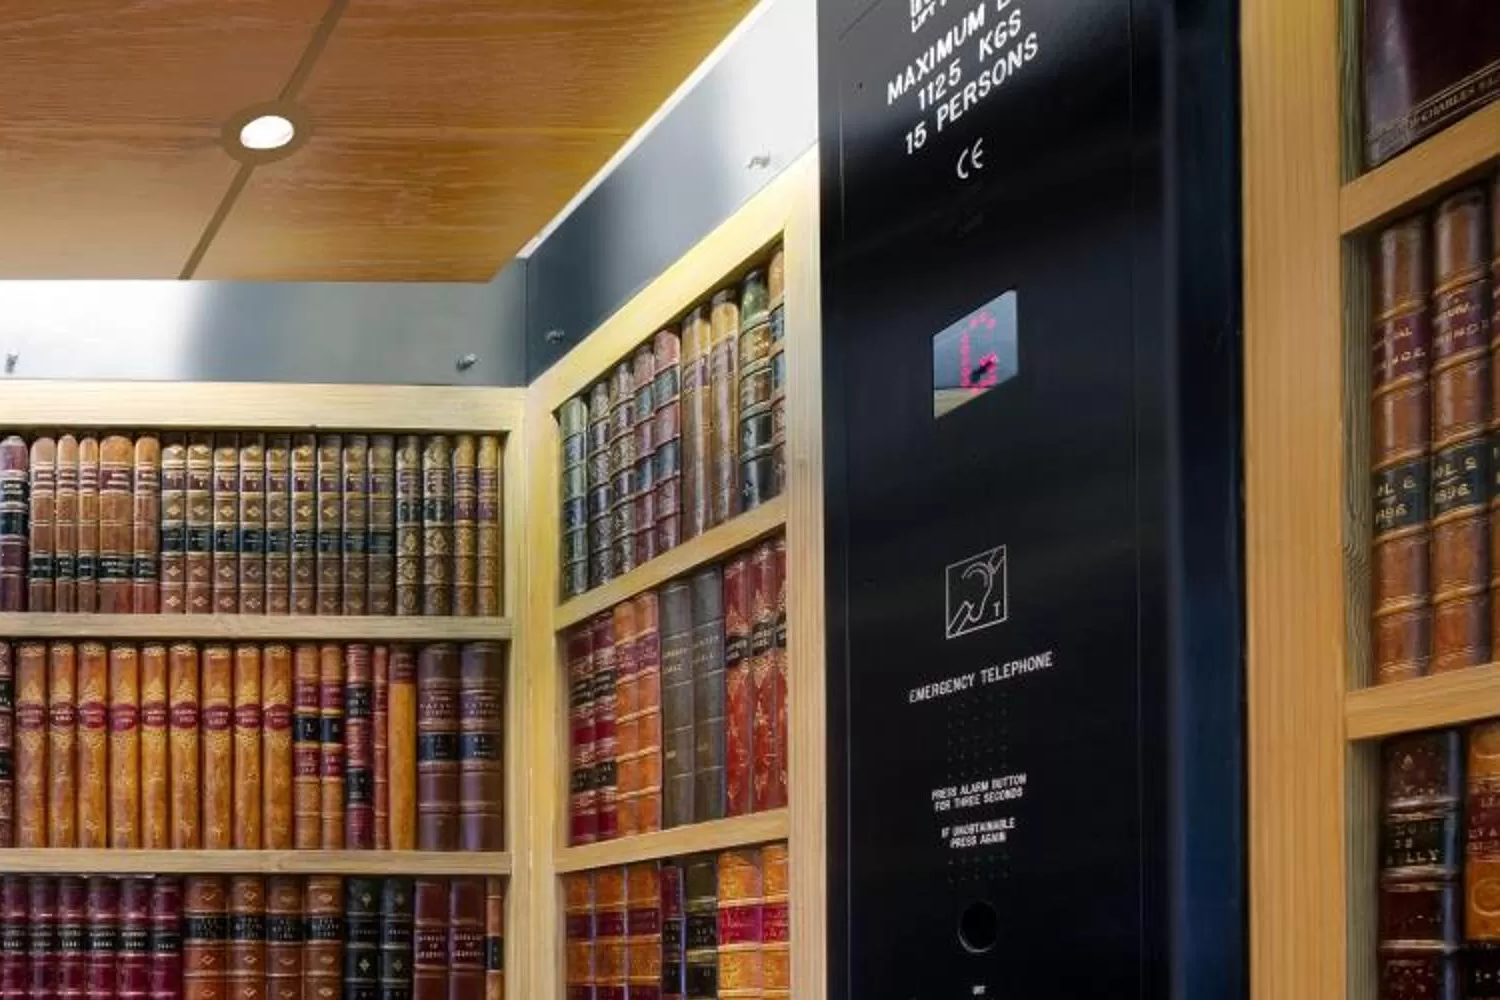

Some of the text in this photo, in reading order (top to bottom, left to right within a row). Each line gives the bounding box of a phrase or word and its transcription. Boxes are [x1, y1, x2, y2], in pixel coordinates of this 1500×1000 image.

[888, 3, 985, 105] MAXIMUM
[918, 58, 961, 111] 1125
[979, 9, 1021, 62] KGS
[905, 32, 1038, 154] 15 PERSONS
[909, 651, 1053, 703] EMERGENCY TELEPHONE
[931, 772, 1027, 801] PRESS ALARM BUTTON
[934, 786, 1023, 812] FOR THREE SECONDS
